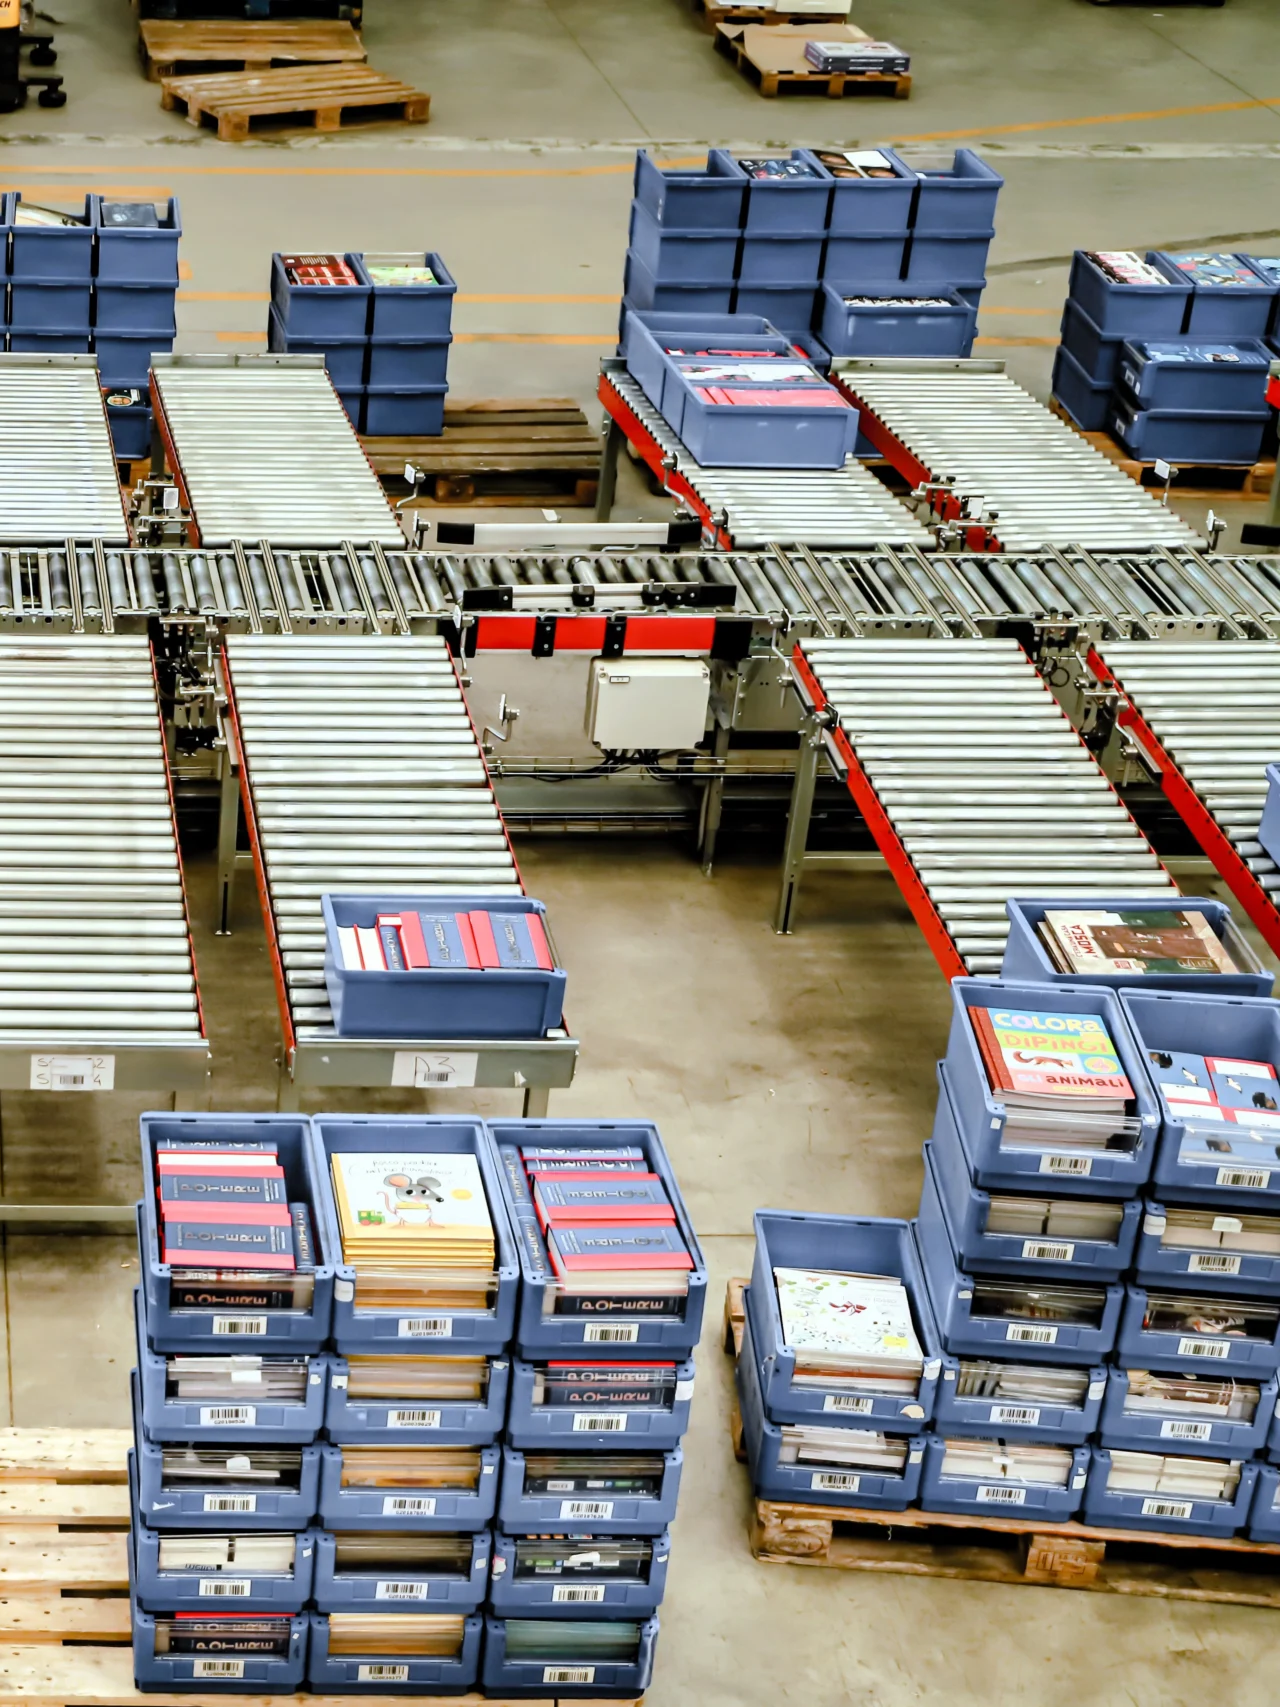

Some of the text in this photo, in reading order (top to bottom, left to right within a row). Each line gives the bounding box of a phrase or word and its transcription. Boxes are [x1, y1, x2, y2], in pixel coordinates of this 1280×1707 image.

[1070, 925, 1096, 954] MOSCA
[180, 1184, 261, 1194] POTERE
[567, 1189, 648, 1200] POTERE
[183, 1231, 267, 1244] POTERE
[184, 1295, 268, 1306] POTERE
[581, 1300, 665, 1311] POTERE
[567, 1371, 650, 1381] POTERE
[569, 1391, 651, 1402] POTERE
[195, 1640, 274, 1650] POTERE
